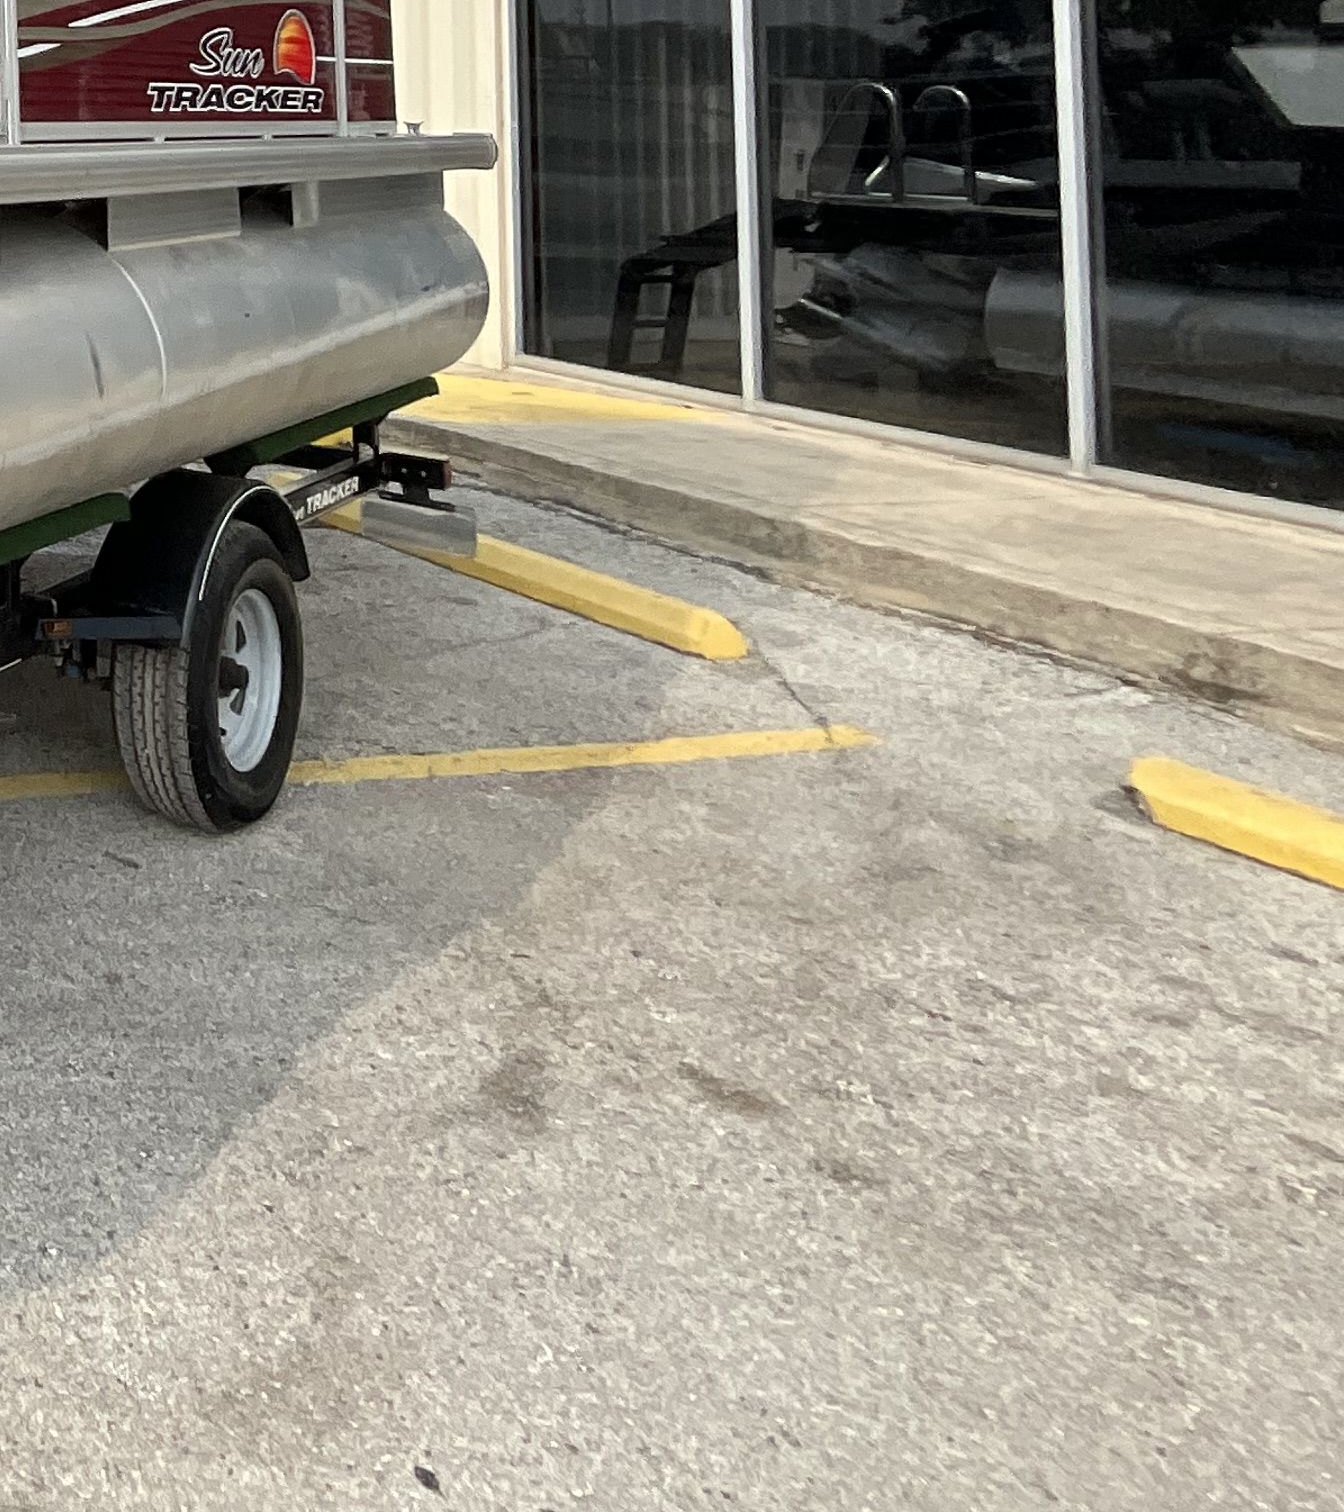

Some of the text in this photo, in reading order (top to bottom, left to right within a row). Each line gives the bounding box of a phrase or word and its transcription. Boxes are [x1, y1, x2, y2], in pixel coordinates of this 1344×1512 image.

[189, 27, 265, 78] Sun
[147, 82, 324, 112] TRACKER
[306, 476, 360, 515] TRACKER
